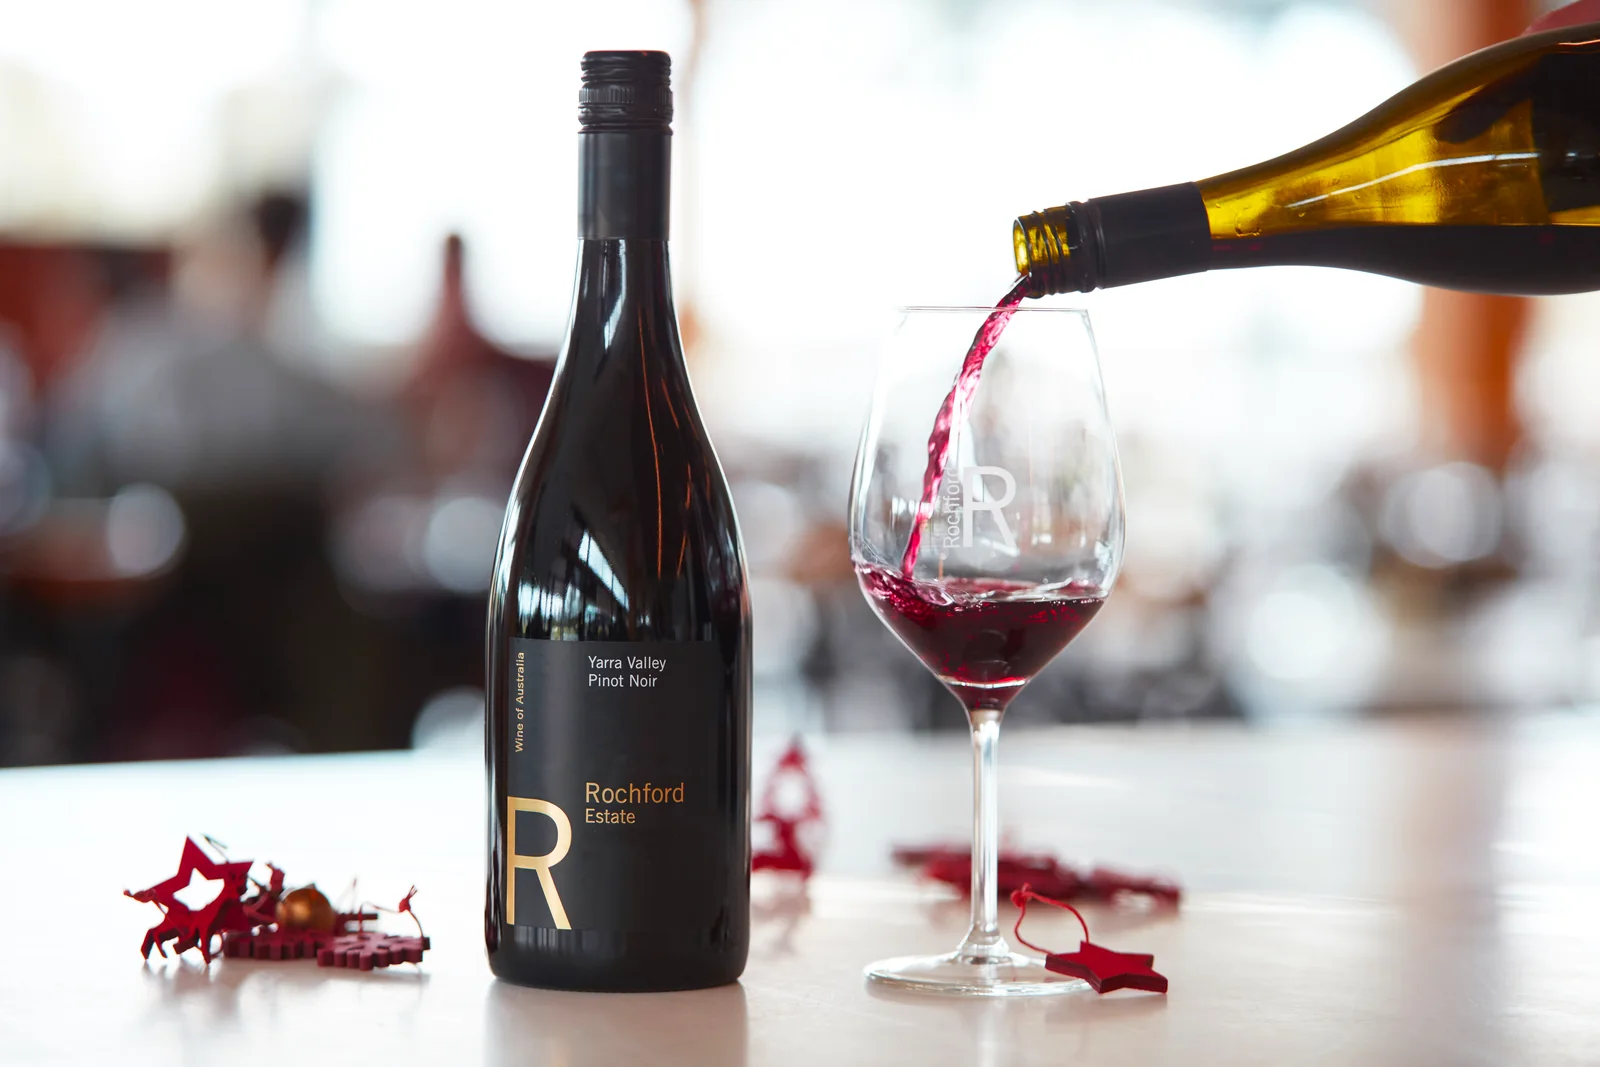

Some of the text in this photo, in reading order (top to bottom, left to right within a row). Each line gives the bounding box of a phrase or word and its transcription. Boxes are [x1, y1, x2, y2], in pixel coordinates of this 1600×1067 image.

[942, 466, 960, 549] Rochford
[962, 465, 1018, 548] R
[587, 655, 667, 672] Yarra Valley
[588, 673, 658, 687] Pinot Noir
[514, 651, 525, 753] Wine of Australia
[585, 781, 684, 804] Rochford
[585, 807, 636, 824] Estate
[506, 795, 572, 930] R
